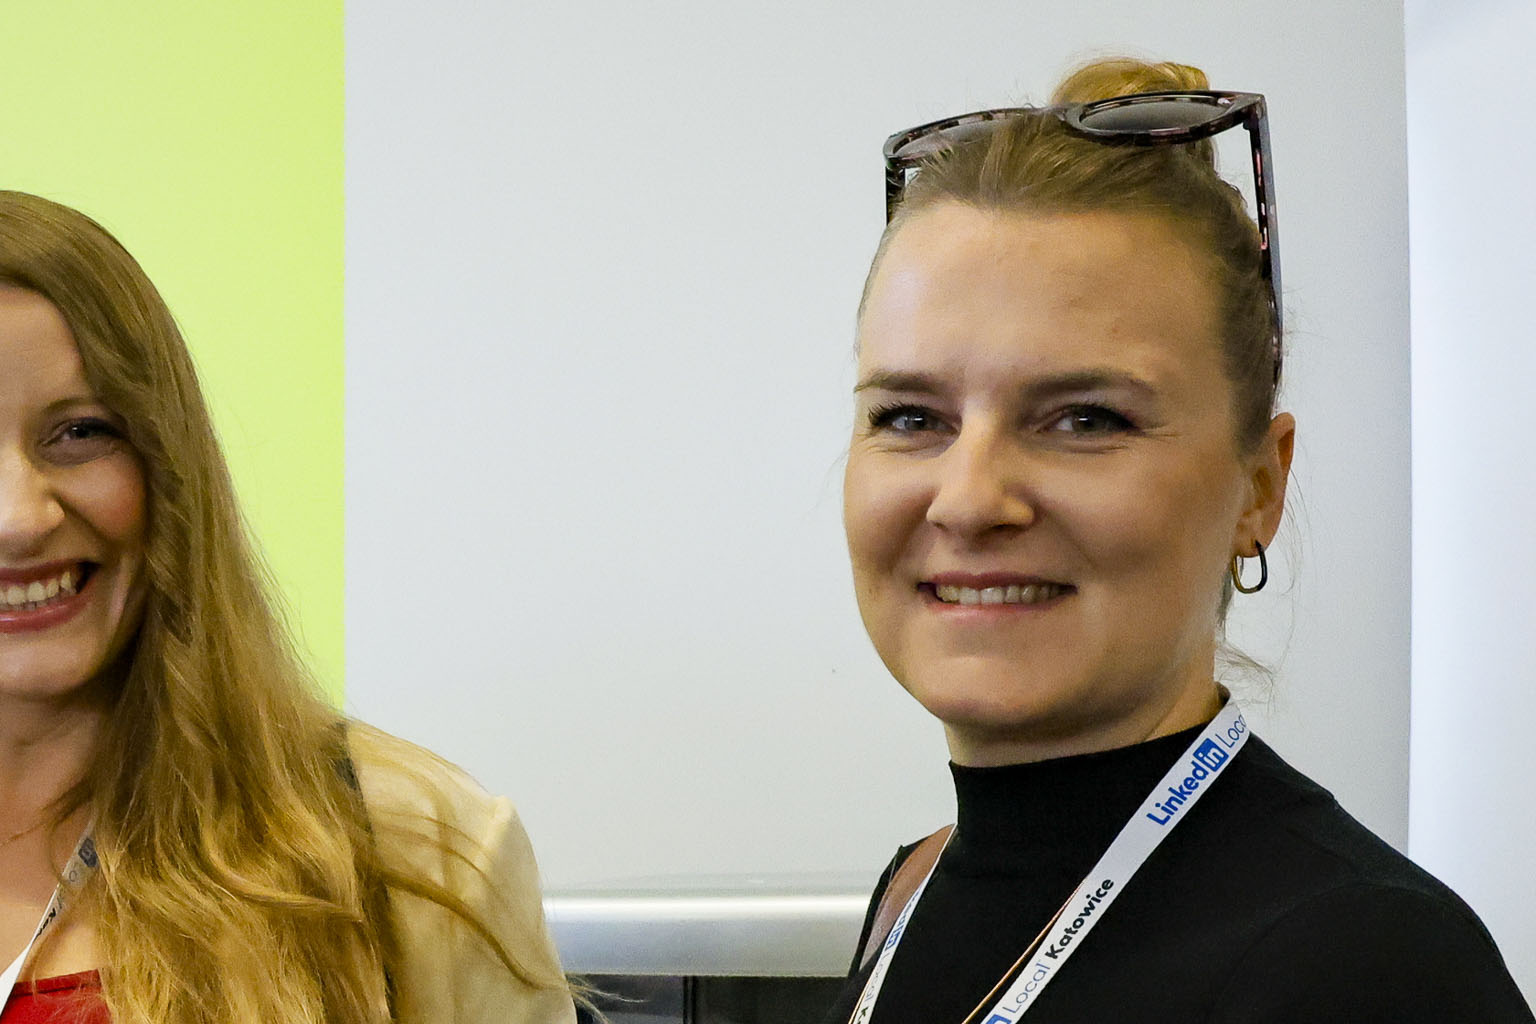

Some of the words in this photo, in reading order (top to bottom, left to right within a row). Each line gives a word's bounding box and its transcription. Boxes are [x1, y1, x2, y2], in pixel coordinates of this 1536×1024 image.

[1215, 713, 1248, 749] Loca
[1002, 961, 1051, 1014] Local
[1044, 878, 1114, 960] Katowice
